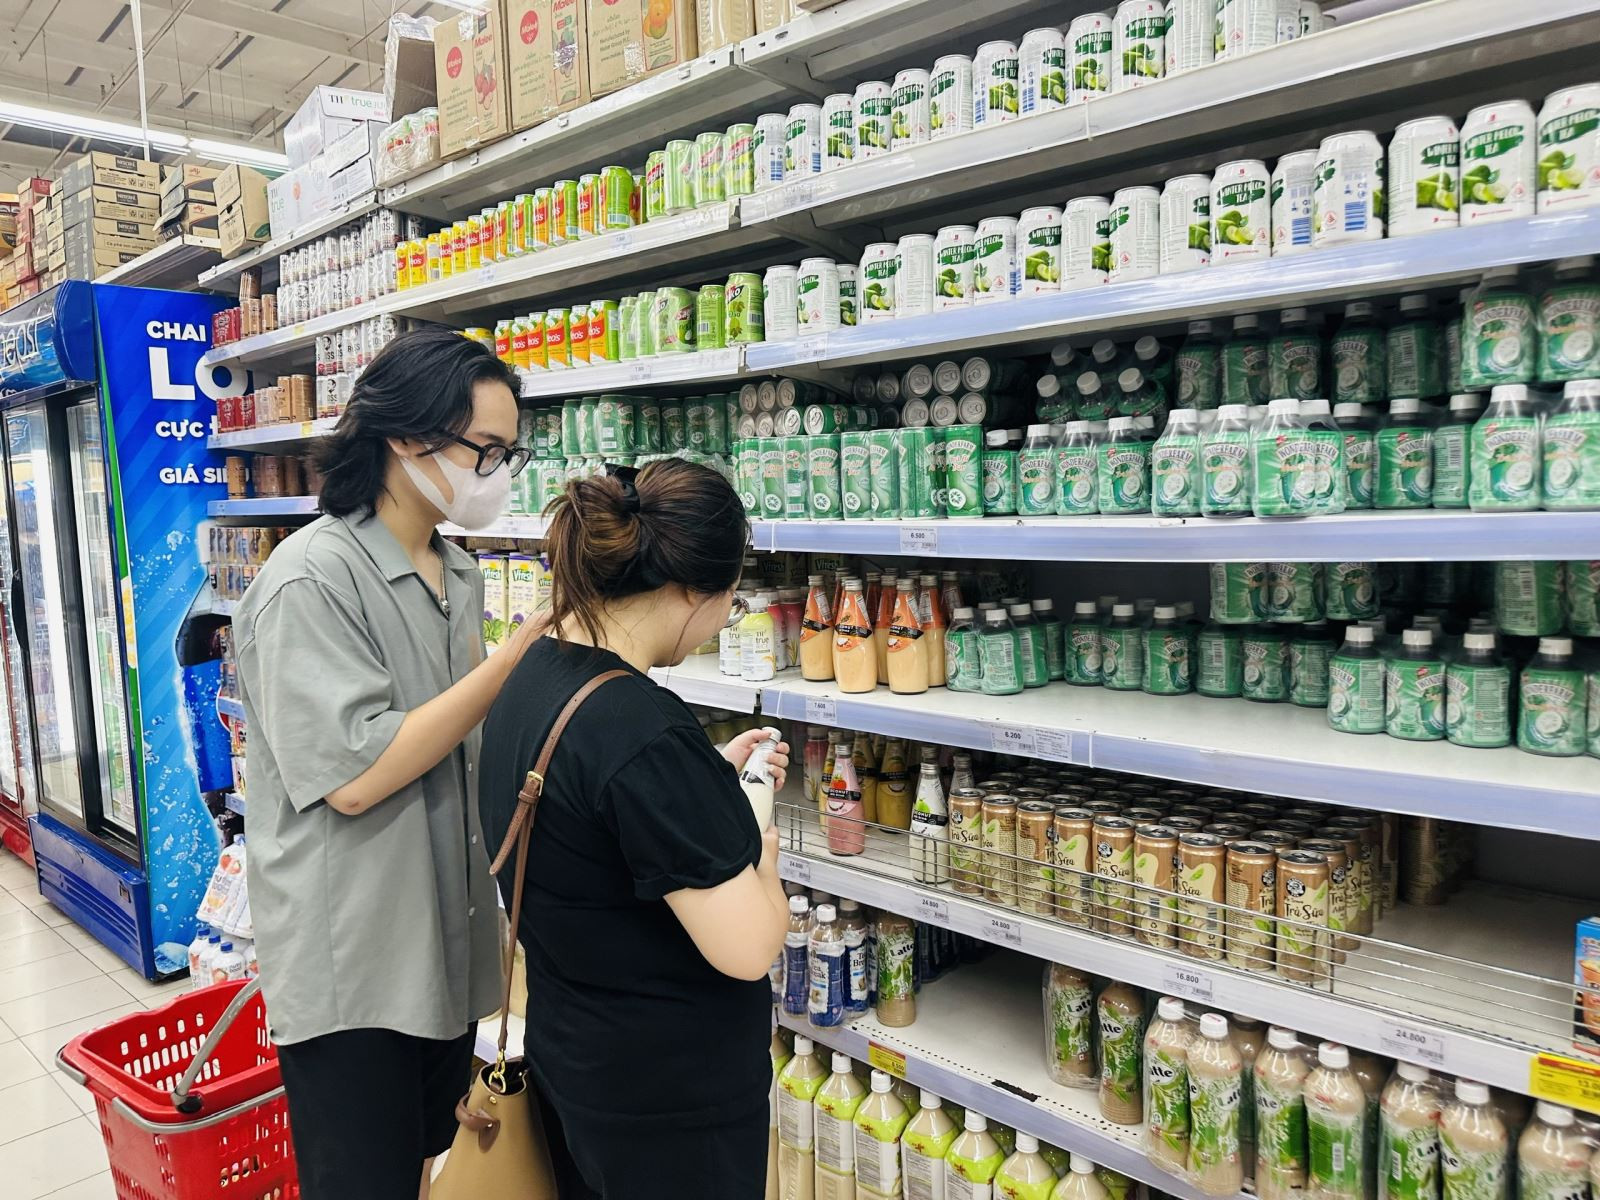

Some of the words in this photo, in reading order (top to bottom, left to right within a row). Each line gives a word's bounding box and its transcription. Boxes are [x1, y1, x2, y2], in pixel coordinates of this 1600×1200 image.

[1485, 143, 1500, 155] TEA
[1219, 184, 1243, 197] WINTER
[1244, 180, 1264, 192] MELON
[1235, 193, 1248, 203] TEA
[146, 320, 207, 342] CHAI
[547, 334, 561, 343] eo's
[1061, 457, 1096, 470] WONDERFARM
[160, 462, 199, 485] GIÁ
[1110, 864, 1131, 879] Sữa
[922, 899, 939, 909] 24.800
[1284, 903, 1302, 917] Trà
[1303, 904, 1324, 920] Sữa
[991, 919, 1011, 931] 24.800
[1175, 972, 1200, 984] 16.800
[1395, 1029, 1427, 1045] 24.800
